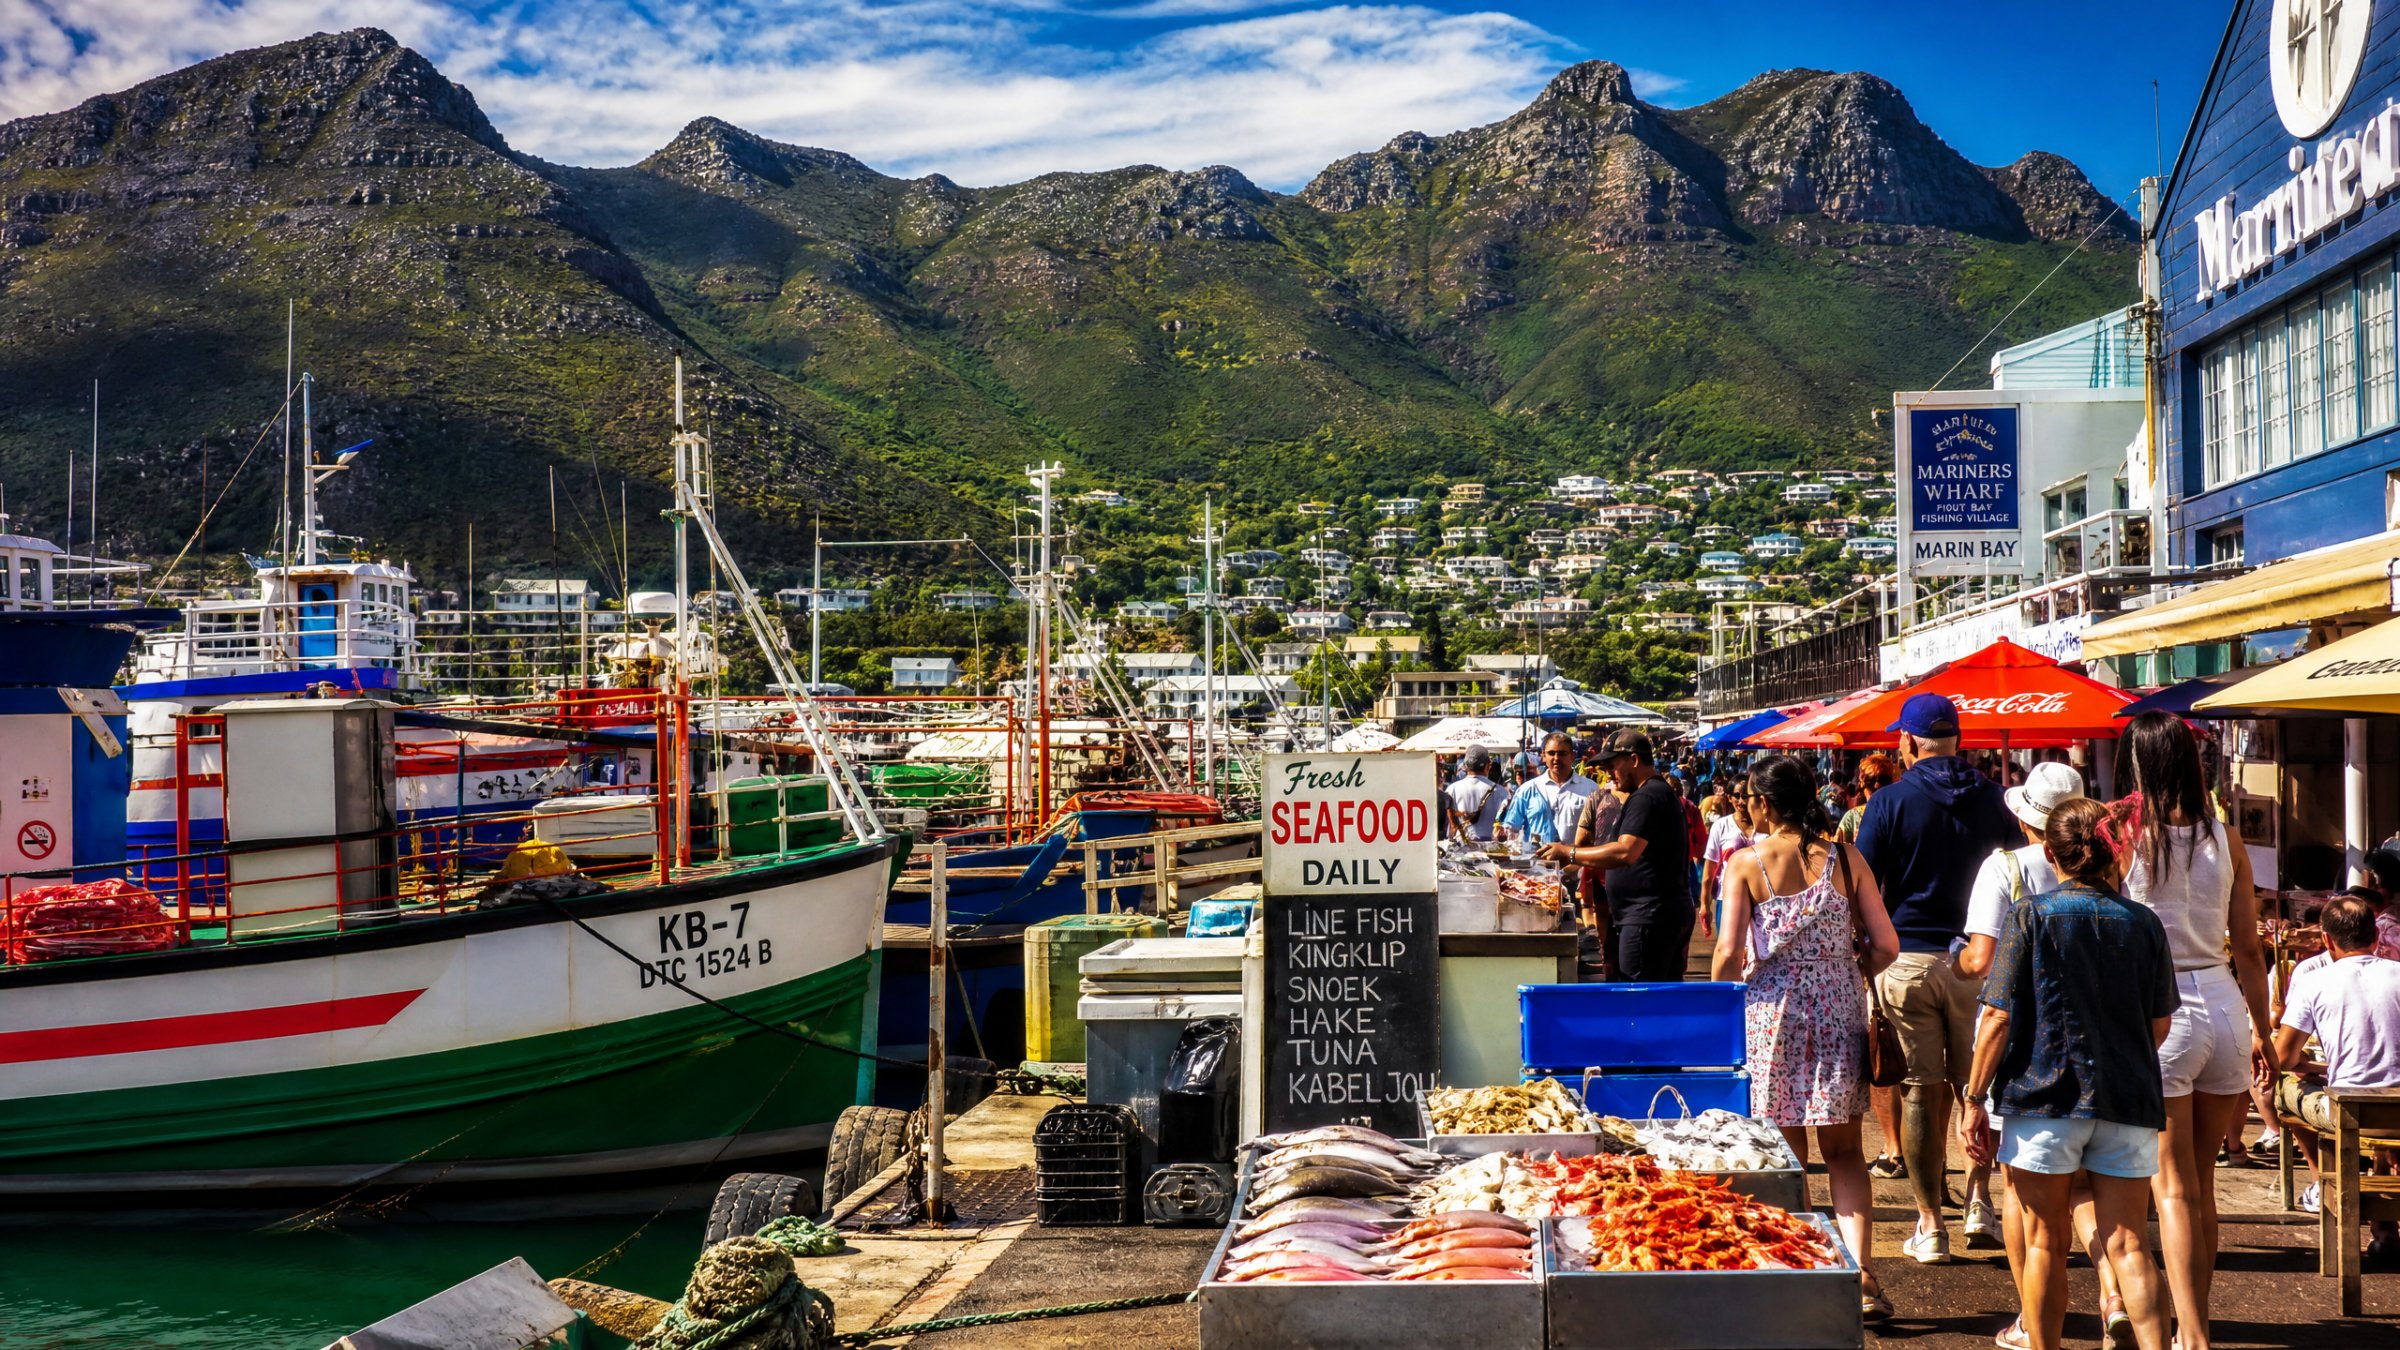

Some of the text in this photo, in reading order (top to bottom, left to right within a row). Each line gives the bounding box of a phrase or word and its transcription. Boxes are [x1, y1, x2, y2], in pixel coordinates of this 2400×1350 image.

[1917, 463, 2012, 480] MARINERS
[1924, 483, 2005, 501] WHARF
[1921, 513, 2010, 523] FISHING VILLAGE
[1915, 540, 2018, 559] MARIN BAY
[1283, 757, 1366, 796] Fresh
[1271, 799, 1428, 845] SEAFOOD
[1302, 858, 1401, 886] DAILY
[658, 901, 750, 954] KB-7
[1357, 907, 1413, 935] FISH
[640, 938, 772, 989] DTC 1524 B
[1289, 940, 1406, 969] KINGKLIP
[1288, 976, 1382, 1003] SNOEK
[1290, 1007, 1376, 1035] HAKE
[1286, 1038, 1378, 1066] TUNA
